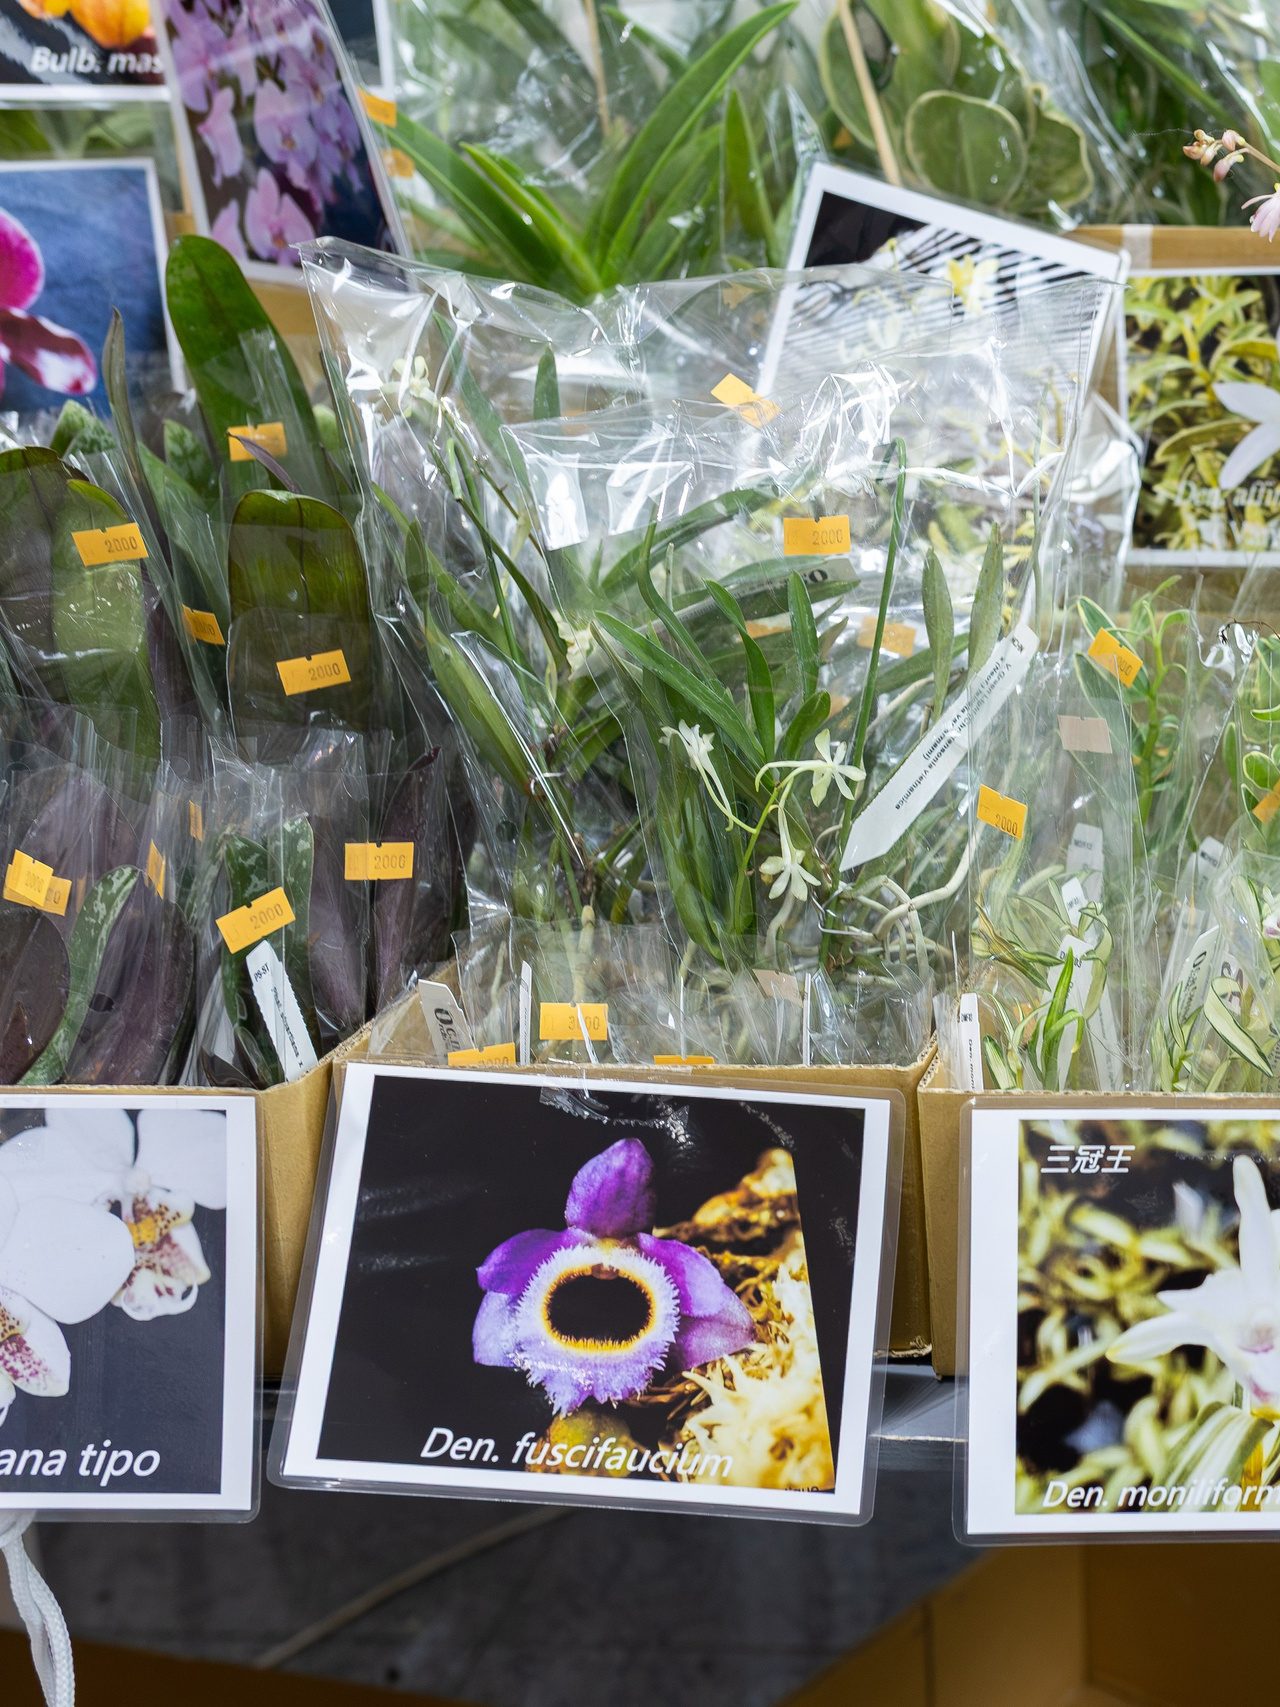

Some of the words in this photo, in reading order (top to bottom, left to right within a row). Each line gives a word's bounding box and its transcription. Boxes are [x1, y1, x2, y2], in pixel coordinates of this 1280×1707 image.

[30, 46, 101, 74] Bulb.
[106, 52, 165, 75] mas
[104, 535, 139, 554] 2000
[812, 528, 844, 547] 2000
[308, 662, 341, 682] 2000
[893, 767, 930, 811] vietnamica
[995, 813, 1018, 836] 2000
[374, 853, 407, 871] 2000
[250, 902, 285, 931] 2000
[1041, 1144, 1137, 1174] 三冠王
[78, 1439, 161, 1487] tipo
[420, 1426, 500, 1463] Den.
[511, 1431, 734, 1478] fuscifaucium
[1042, 1478, 1108, 1509] Den.
